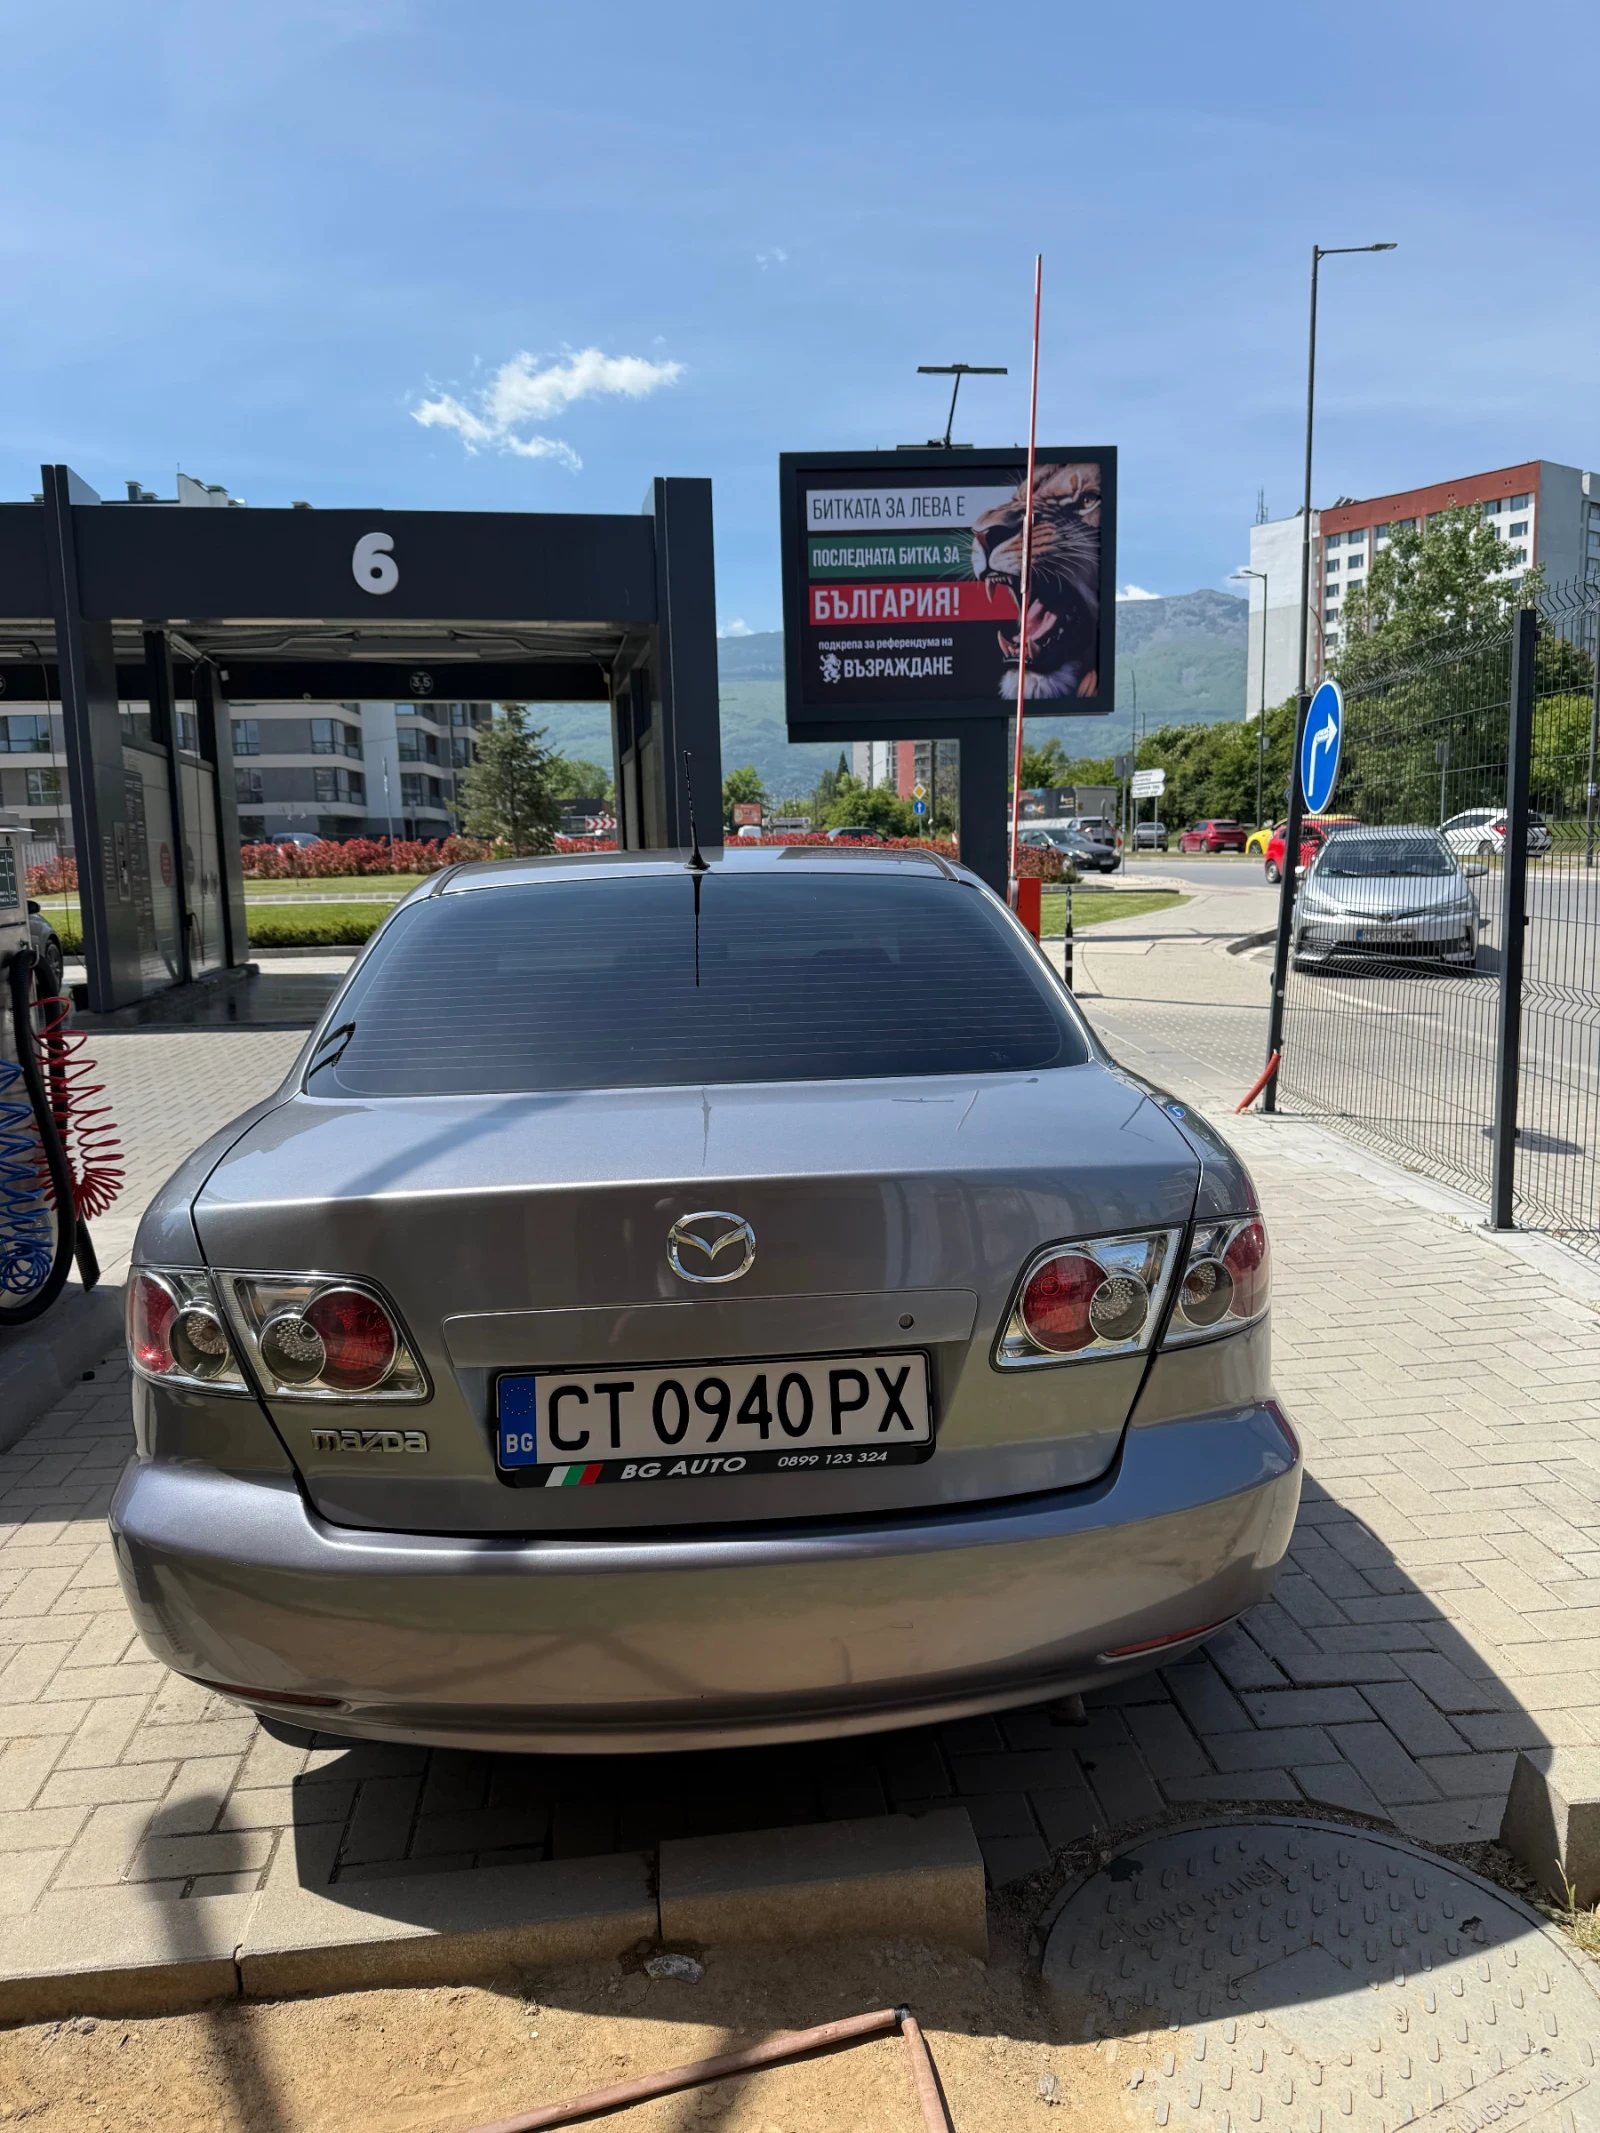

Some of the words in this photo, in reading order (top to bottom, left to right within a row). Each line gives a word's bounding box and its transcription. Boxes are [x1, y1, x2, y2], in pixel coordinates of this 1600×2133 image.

[813, 497, 882, 520] БИТКАТА
[885, 497, 906, 519] ЗА
[910, 496, 952, 518] ЛЕВА
[956, 495, 966, 517] Е
[351, 531, 399, 595] 6
[812, 547, 896, 568] ПОСЛЕДНАТА
[899, 546, 941, 565] БИТКА
[943, 545, 960, 564] ЗА
[814, 586, 960, 620] БЪЛГАРИЯ!
[818, 640, 863, 652] подкрепа
[864, 640, 875, 649] за
[876, 637, 940, 650] референдума
[941, 637, 953, 647] на
[843, 656, 953, 678] ВЪЗРАЖДАНЕ
[548, 1381, 635, 1451] CT
[651, 1373, 814, 1446] 0940
[829, 1366, 915, 1436] PX
[506, 1432, 533, 1454] BG
[620, 1463, 663, 1480] BG
[667, 1456, 747, 1476] AUTO
[777, 1455, 820, 1467] 0899
[825, 1453, 853, 1465] 123
[857, 1451, 888, 1463] 324
